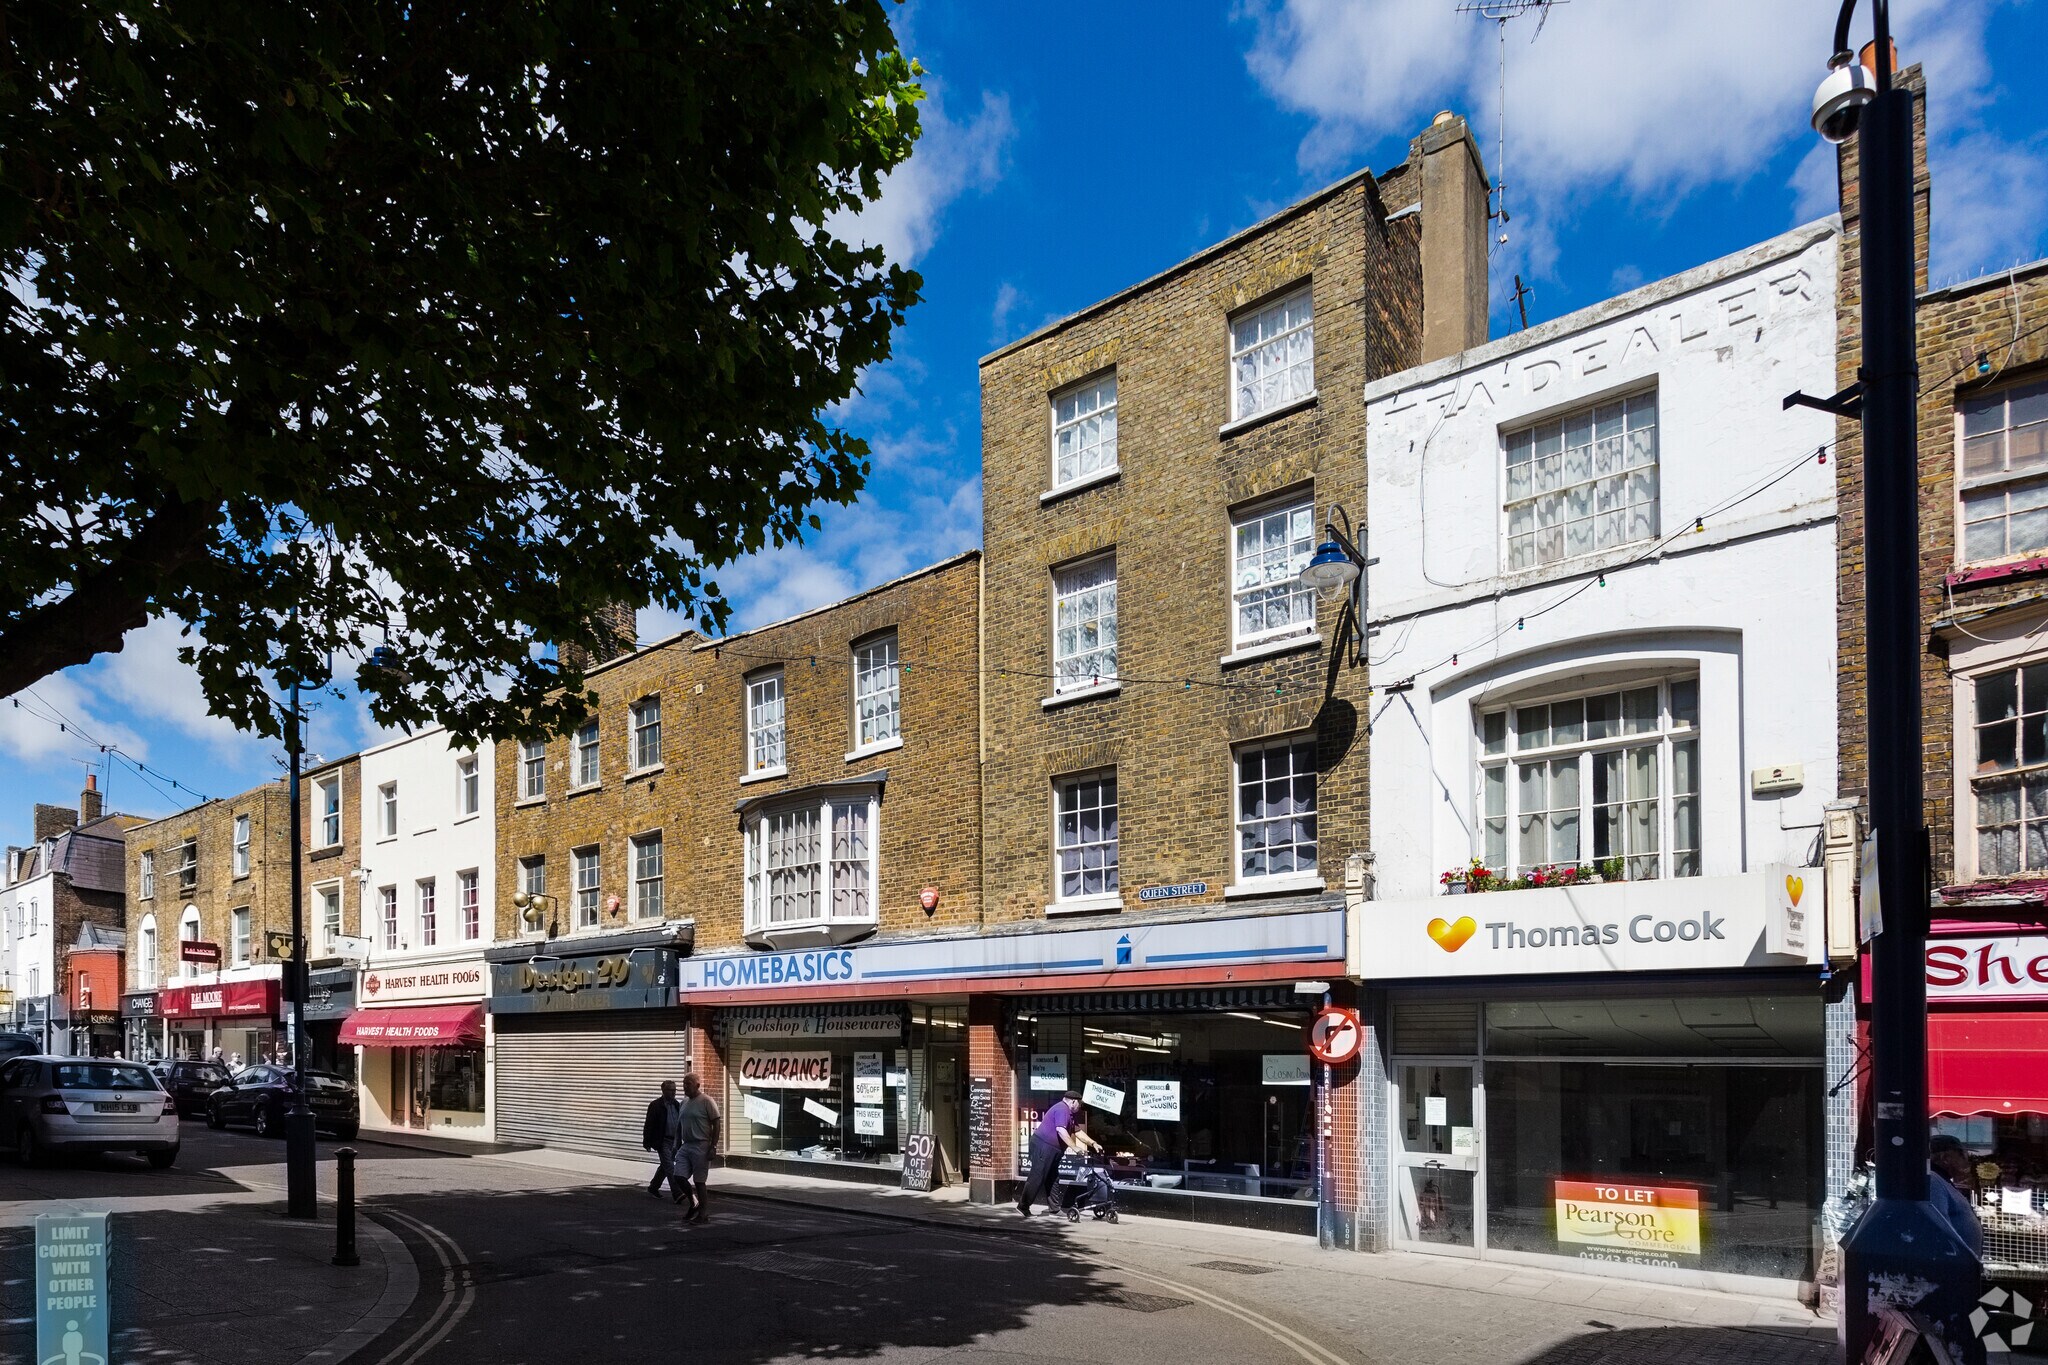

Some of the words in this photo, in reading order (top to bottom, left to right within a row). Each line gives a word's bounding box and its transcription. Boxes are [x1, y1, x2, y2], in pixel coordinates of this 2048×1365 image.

[1142, 889, 1170, 899] QUEEN
[1171, 883, 1203, 896] STREET
[1485, 921, 1619, 949] Thomas
[1628, 910, 1726, 943] Cook
[519, 961, 594, 992] Design
[596, 957, 632, 988] 29
[704, 951, 853, 987] HOMEBASICS
[385, 976, 416, 989] HARVEST
[420, 973, 449, 986] HEALTH
[452, 970, 480, 984] FOODS
[132, 998, 153, 1009] CHANGES
[356, 1027, 385, 1036] HARVEST
[385, 1027, 412, 1037] HEALTH
[413, 1027, 439, 1037] FOODS
[738, 1019, 800, 1036] Cookshop
[803, 1020, 810, 1033] &
[815, 1018, 901, 1034] Housewares
[741, 1057, 829, 1082] CLEARANCE
[1092, 1085, 1102, 1093] THIS
[1102, 1088, 1117, 1098] WEEK
[1096, 1095, 1109, 1103] ONLY
[856, 1110, 867, 1118] THIS
[867, 1111, 881, 1119] WEEK
[862, 1120, 875, 1128] ONLY
[910, 1158, 926, 1169] OFF
[903, 1167, 914, 1176] ALL
[908, 1176, 928, 1189] TODAY
[1595, 1187, 1619, 1200] TO
[1624, 1189, 1655, 1203] LET
[1565, 1203, 1656, 1228] Pearson
[52, 1226, 90, 1240] LIMIT
[1614, 1220, 1675, 1243] Gore
[39, 1243, 103, 1258] CONTACT
[1586, 1245, 1669, 1259] www.pearsongore.co.uk
[1628, 1240, 1693, 1251] COMMERCIAL
[52, 1261, 90, 1275] WITH
[49, 1278, 94, 1293] OTHER
[47, 1295, 97, 1311] PEOPLE
